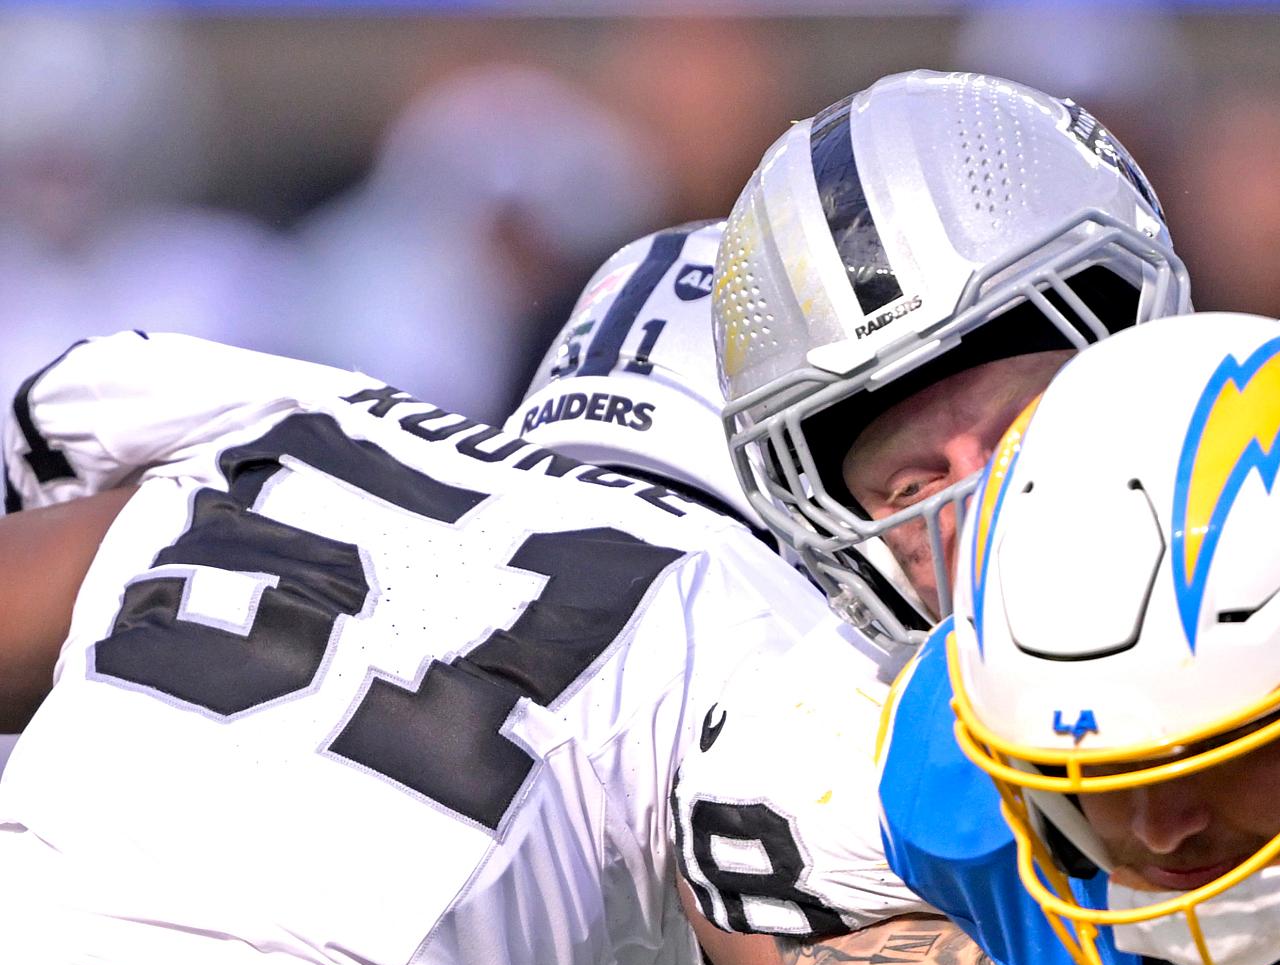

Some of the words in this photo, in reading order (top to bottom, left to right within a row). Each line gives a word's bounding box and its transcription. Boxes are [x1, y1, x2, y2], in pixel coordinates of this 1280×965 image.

[518, 392, 656, 438] RAIDERS
[86, 408, 700, 840] 51
[1052, 709, 1099, 742] LA
[672, 782, 857, 937] 8
